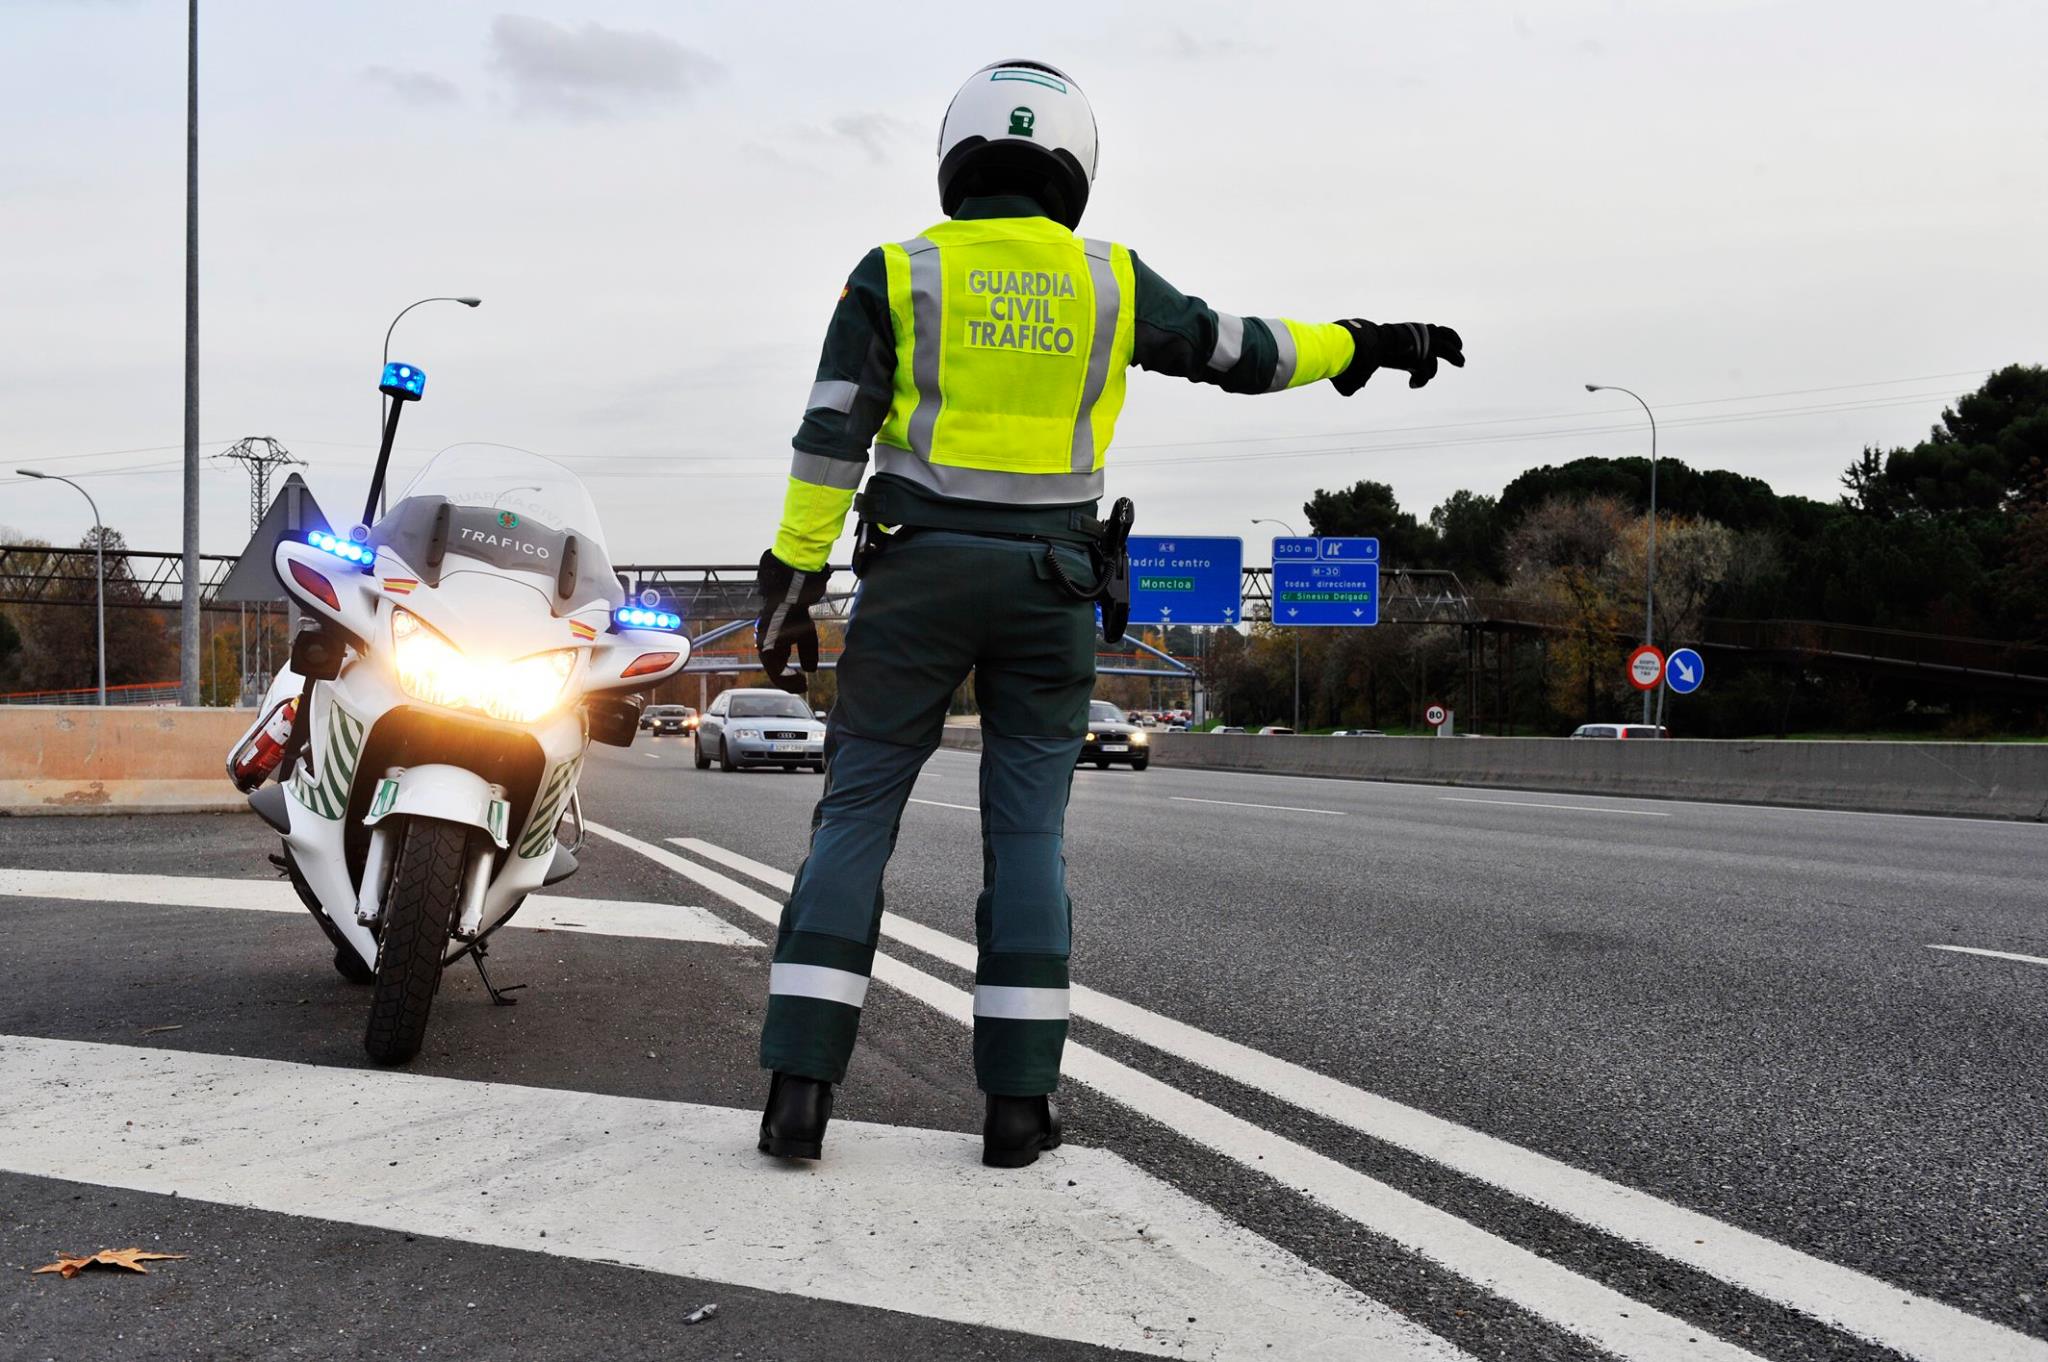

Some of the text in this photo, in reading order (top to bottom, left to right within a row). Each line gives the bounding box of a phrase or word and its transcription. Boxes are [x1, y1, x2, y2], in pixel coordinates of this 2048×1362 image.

[969, 270, 1075, 298] GUARDIA
[990, 296, 1055, 324] CIVIL
[968, 320, 1074, 353] TRAFICO
[460, 528, 550, 559] TRAFICO
[1159, 543, 1175, 553] A-6
[1279, 544, 1313, 553] 500 m
[1365, 545, 1373, 554] 6
[1171, 558, 1211, 568] centro
[1312, 567, 1339, 576] M-30
[1141, 579, 1192, 589] Moncloa
[1284, 580, 1367, 588] todas direcciones
[1297, 592, 1330, 601] Sinesio
[1333, 592, 1369, 603] Delgado
[1428, 710, 1443, 720] 80
